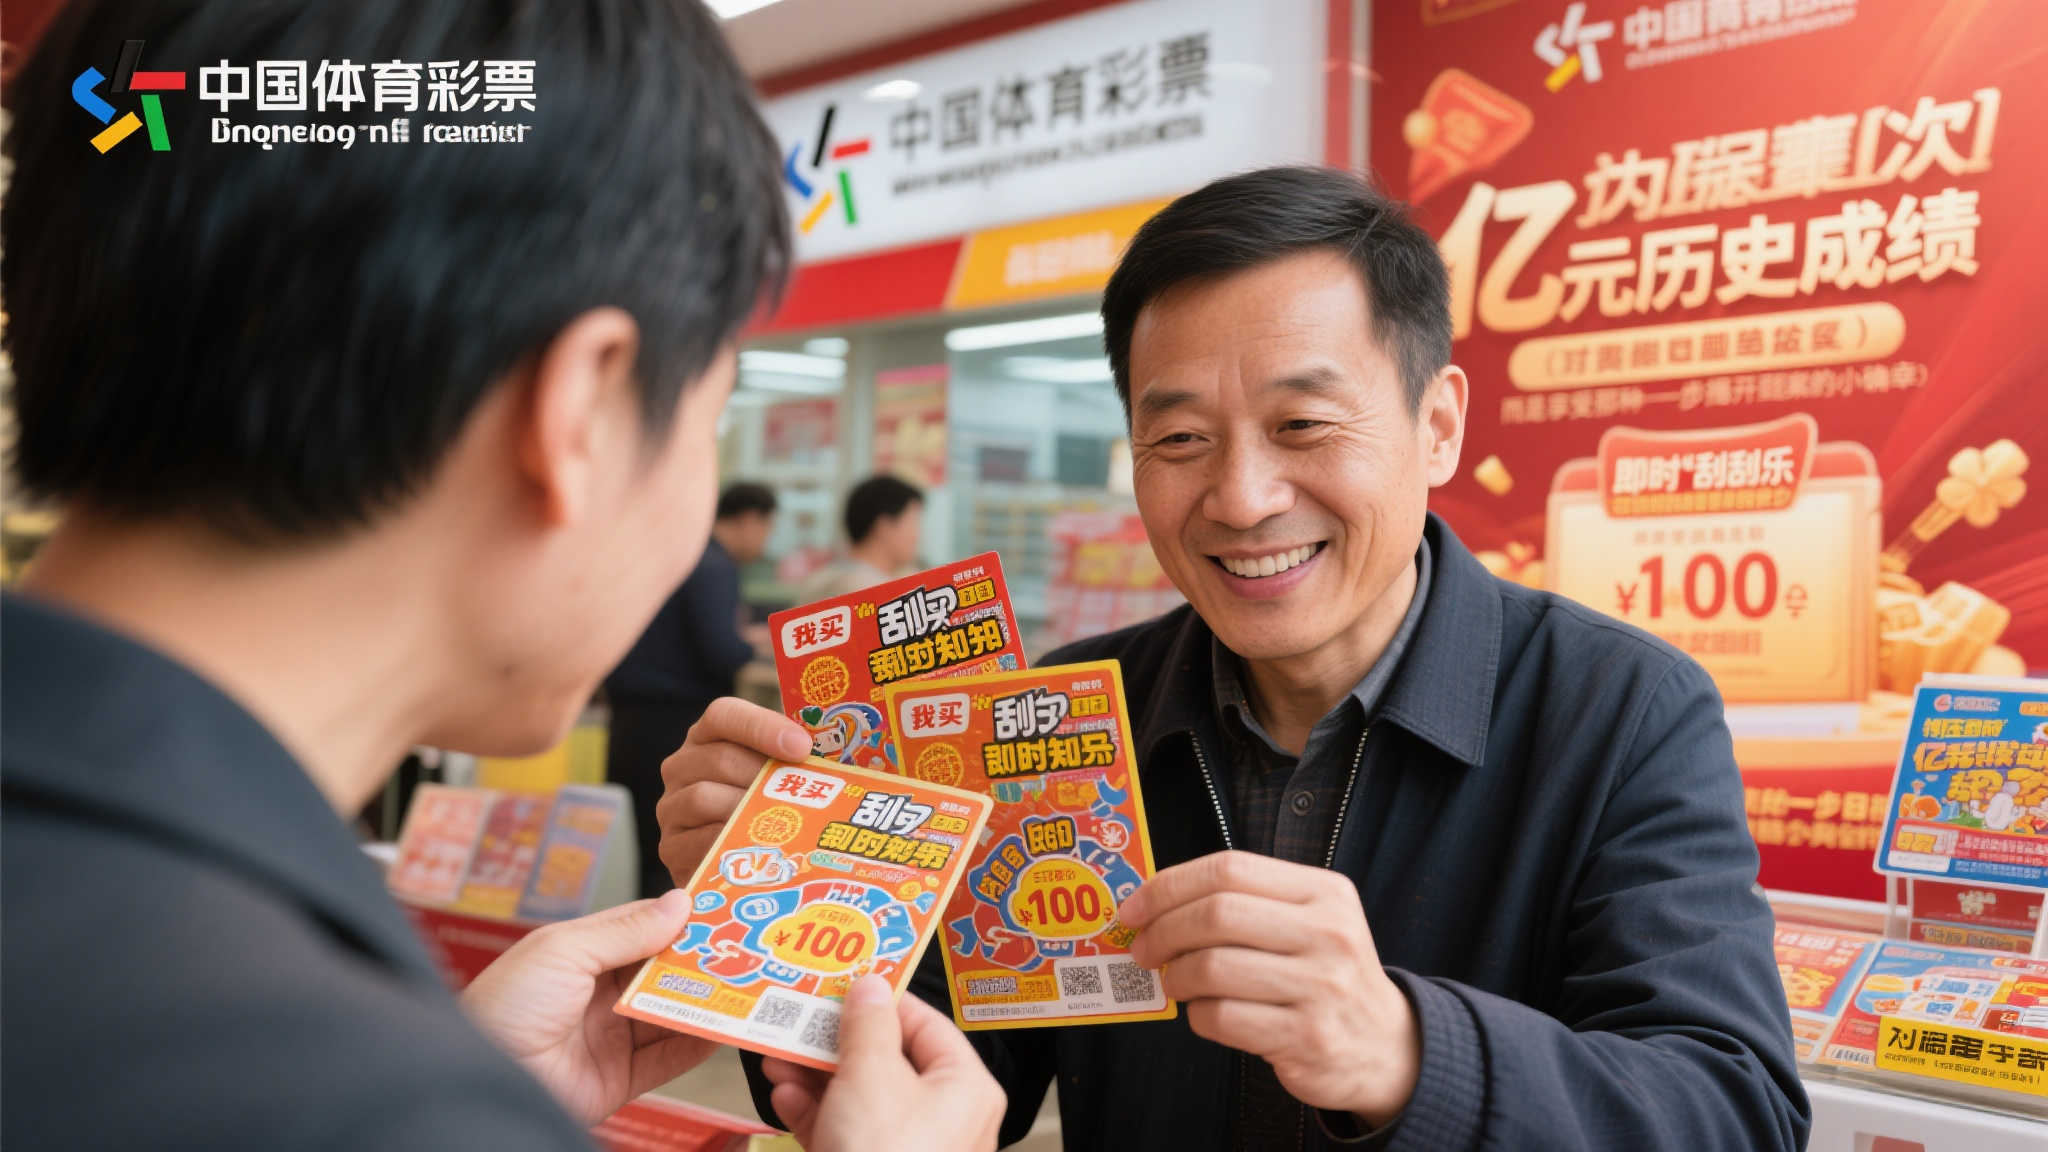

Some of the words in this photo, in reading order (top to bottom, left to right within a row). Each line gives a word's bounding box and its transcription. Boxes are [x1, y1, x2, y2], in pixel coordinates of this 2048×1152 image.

[888, 31, 1212, 162] 中国体育彩票
[911, 700, 964, 731] 我买
[773, 921, 866, 964] ¥100
